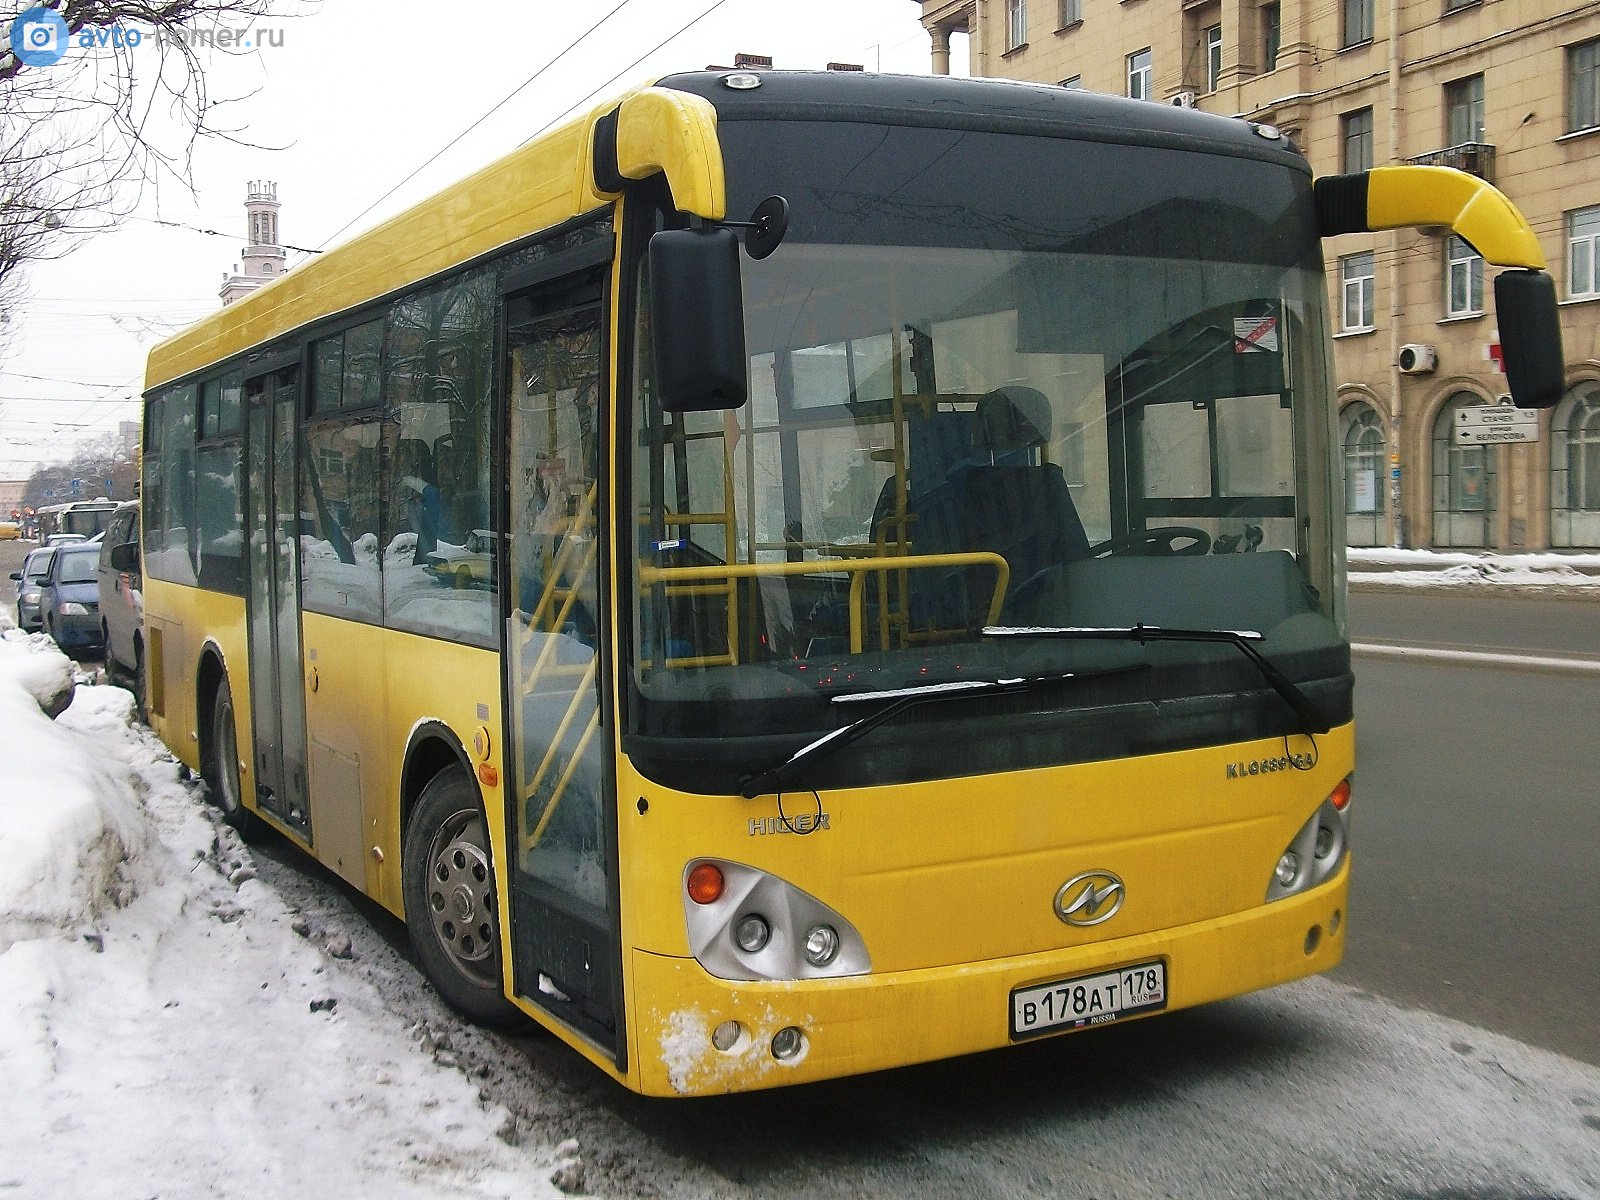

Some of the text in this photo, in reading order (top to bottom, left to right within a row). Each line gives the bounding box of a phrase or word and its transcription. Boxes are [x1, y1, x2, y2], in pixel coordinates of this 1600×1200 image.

[1482, 415, 1514, 423] СТАЧЕК
[1476, 432, 1526, 441] БЕЛОУСОВА
[747, 812, 830, 836] HIGER
[1023, 969, 1157, 1026] В178АТ 178
[1131, 992, 1148, 1005] RUS
[1090, 1012, 1116, 1025] RUSSIA
